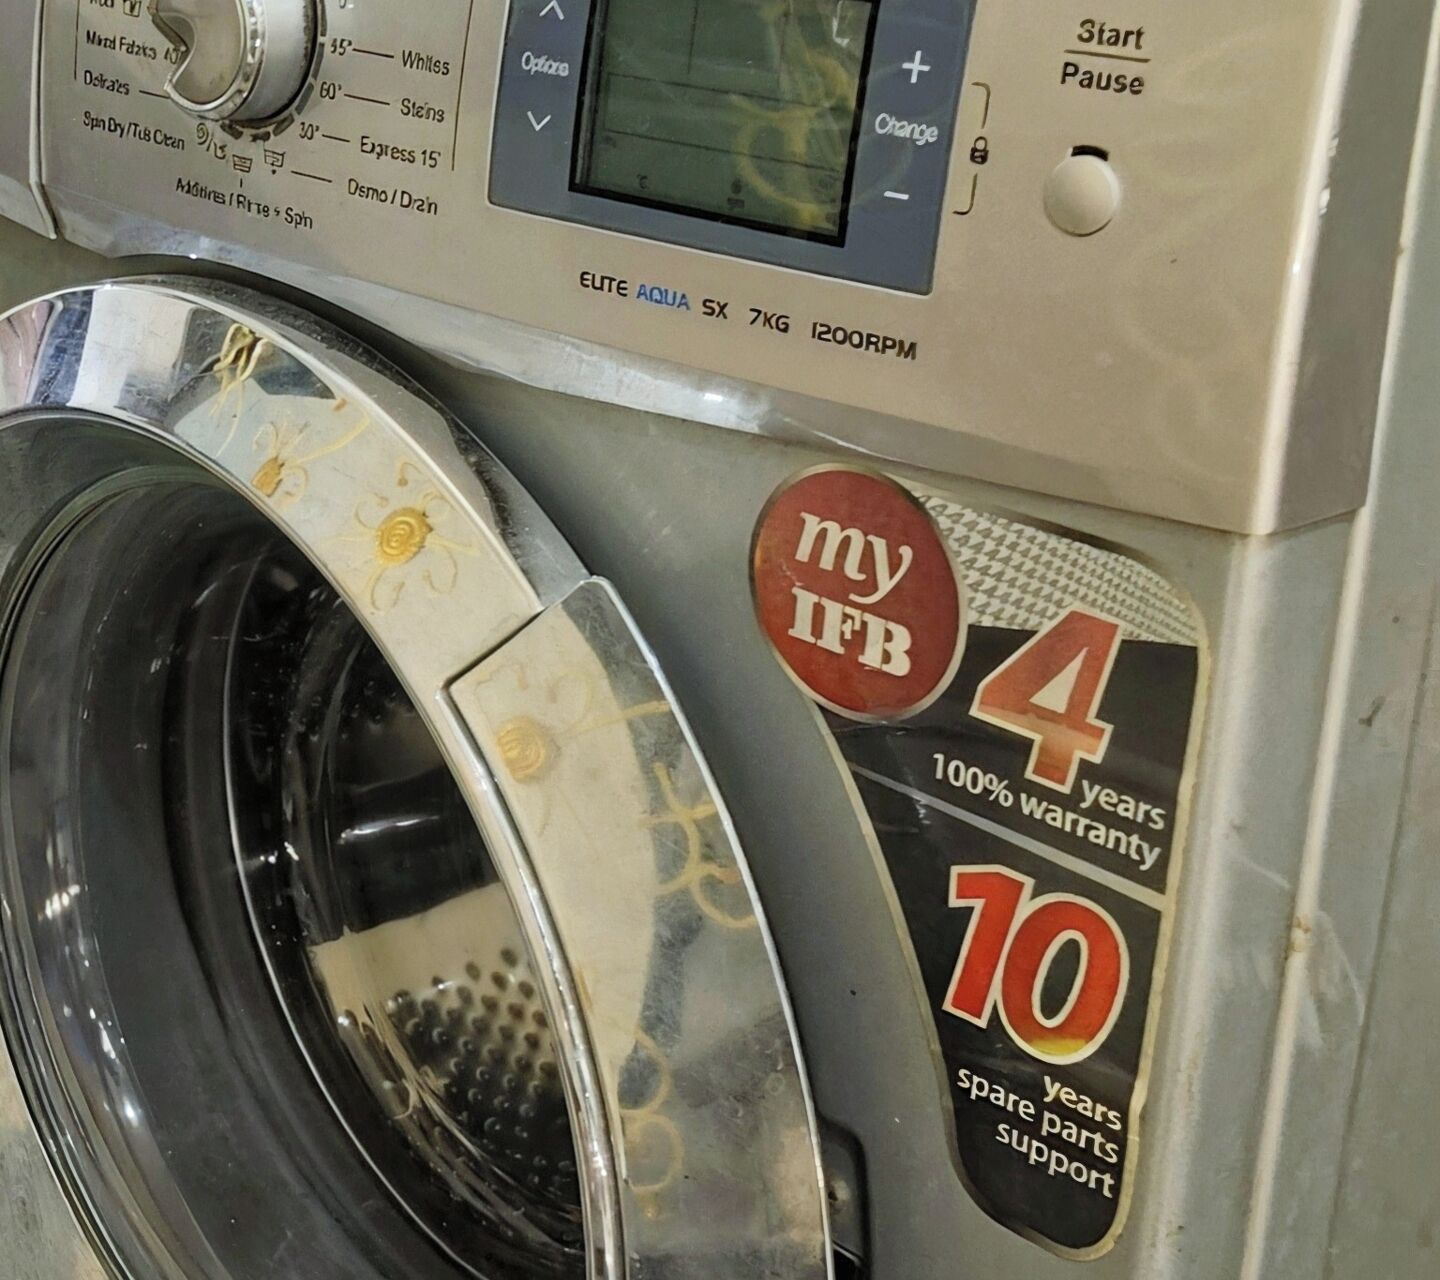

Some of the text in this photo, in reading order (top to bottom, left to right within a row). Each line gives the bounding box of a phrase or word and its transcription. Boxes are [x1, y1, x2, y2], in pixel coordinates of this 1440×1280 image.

[1077, 18, 1146, 51] Start
[1060, 61, 1146, 96] Pause
[361, 135, 416, 164] Express
[875, 113, 939, 146] Change
[284, 206, 313, 230] Spin
[579, 271, 629, 298] ELITE
[636, 283, 691, 311] AQUA
[702, 298, 729, 320] SX
[811, 320, 918, 361] 1200RPM
[794, 511, 914, 605] my
[788, 586, 913, 677] IFB
[968, 608, 1122, 795] 4
[932, 753, 1162, 872] 100% warranty
[1079, 778, 1168, 831] years
[941, 864, 1130, 1066] 10
[957, 1068, 1120, 1165] spare parts
[1043, 1075, 1123, 1131] years
[995, 1122, 1116, 1199] support
